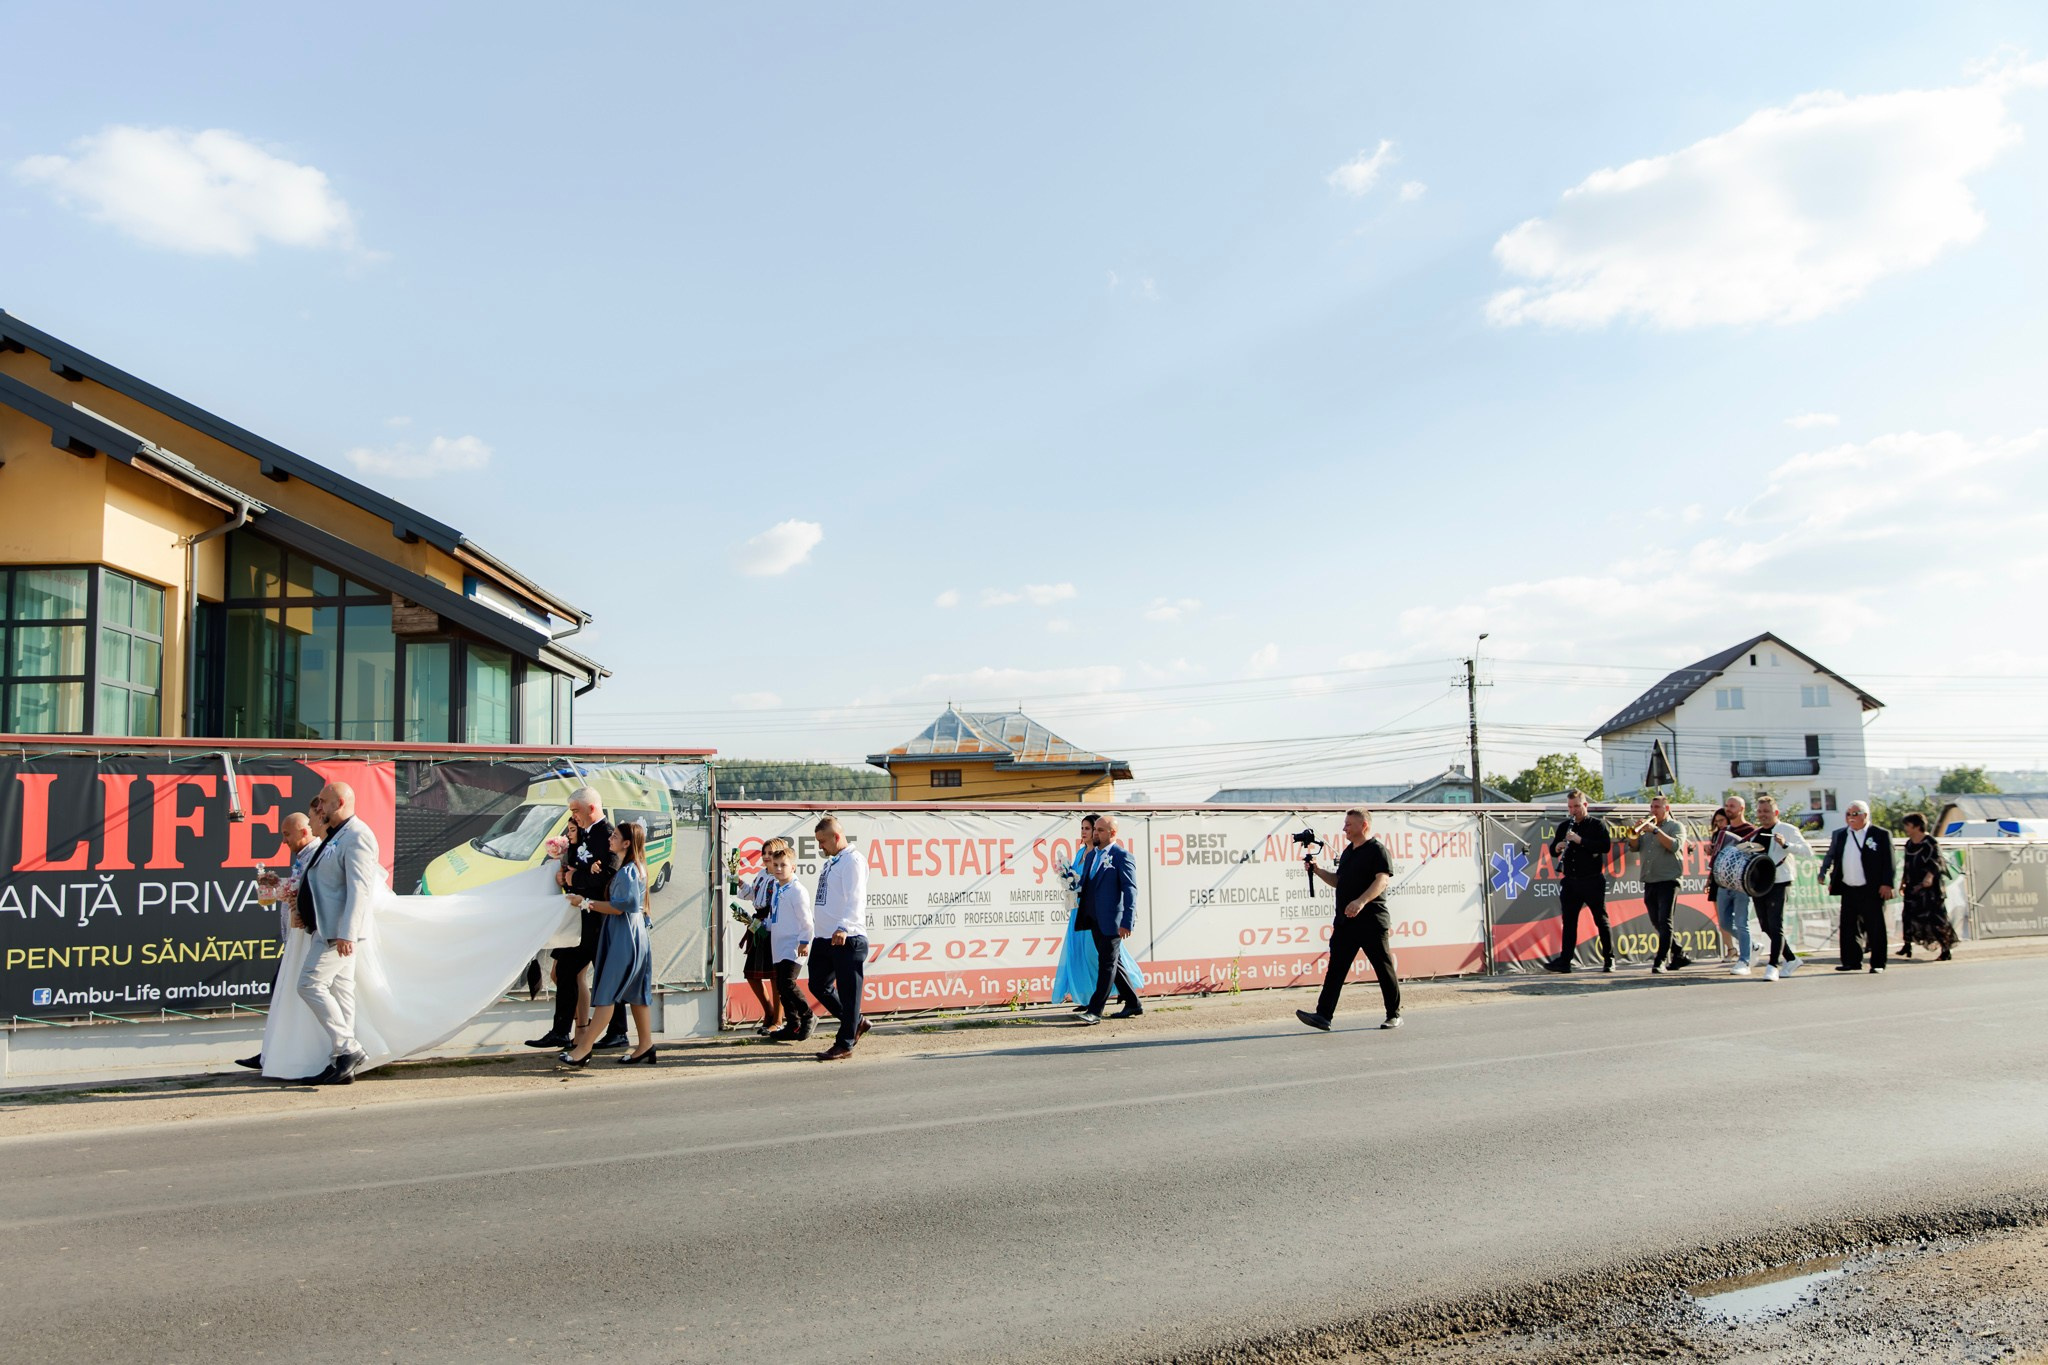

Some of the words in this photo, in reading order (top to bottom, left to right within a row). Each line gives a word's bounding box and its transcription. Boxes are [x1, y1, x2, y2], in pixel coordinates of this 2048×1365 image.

[12, 773, 293, 872] LIFE
[1186, 833, 1227, 848] BEST
[867, 838, 1015, 877] ATESTATE
[1186, 849, 1261, 865] MEDICAL
[138, 880, 277, 915] PRIVA
[866, 893, 909, 906] PERSOANE
[1219, 886, 1280, 904] MEDICALE
[1285, 888, 1309, 902] pentr
[1387, 881, 1437, 896] eschimbare
[1437, 880, 1466, 896] permis
[883, 913, 933, 927] INSTRUCTOR
[934, 912, 956, 925] AUTO
[964, 911, 1003, 925] PROFESOR
[1238, 926, 1310, 946] 0752
[1617, 933, 1660, 955] 0230
[1694, 929, 1717, 950] 112
[6, 944, 133, 970] PENTRU
[868, 942, 934, 963] 742
[945, 938, 1010, 959] 027
[1022, 936, 1063, 956] 77
[863, 977, 974, 1000] SUCEAVA,
[979, 975, 1000, 995] în
[1143, 965, 1200, 985] onului
[1262, 960, 1287, 977] vis
[1291, 958, 1313, 976] de
[53, 984, 160, 1005] Ambu-Life
[165, 980, 270, 999] ambulanta
